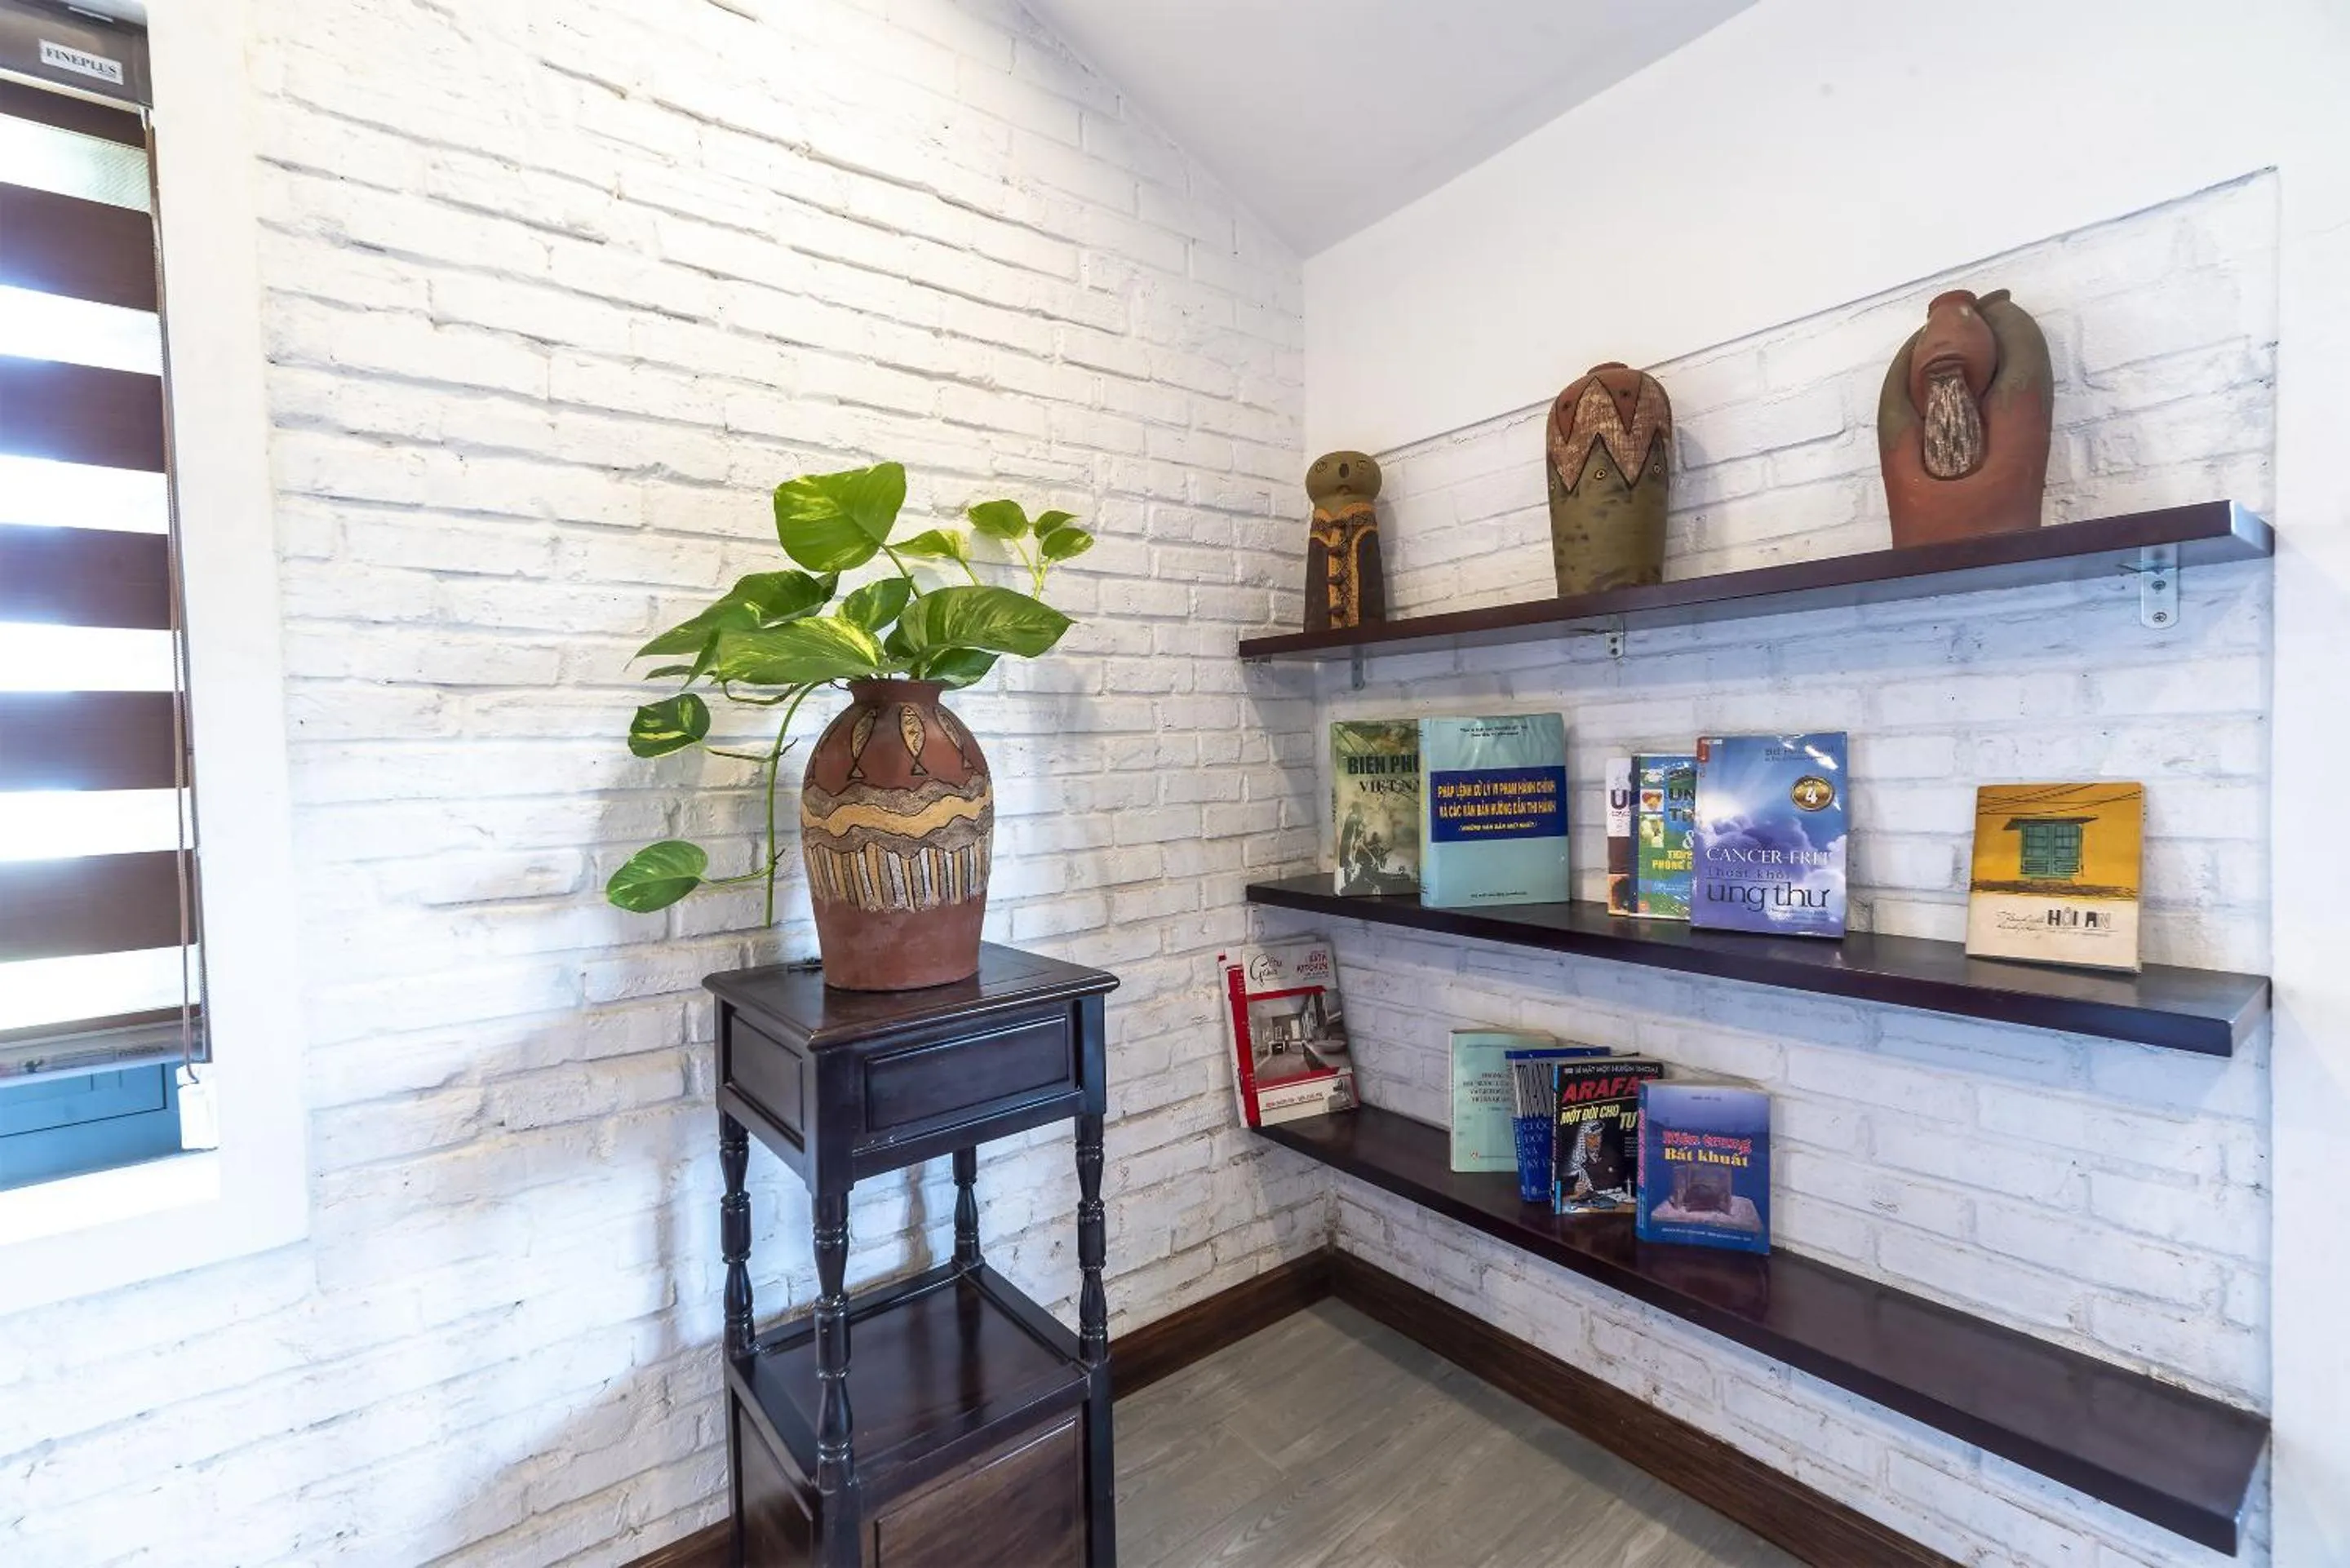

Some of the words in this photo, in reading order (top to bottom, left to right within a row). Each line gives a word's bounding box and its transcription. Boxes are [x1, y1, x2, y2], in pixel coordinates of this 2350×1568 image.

[46, 47, 118, 75] FINEPLUS
[1805, 786, 1819, 804] 4
[1706, 883, 1767, 913] ung
[1561, 1074, 1658, 1104] ARAFA
